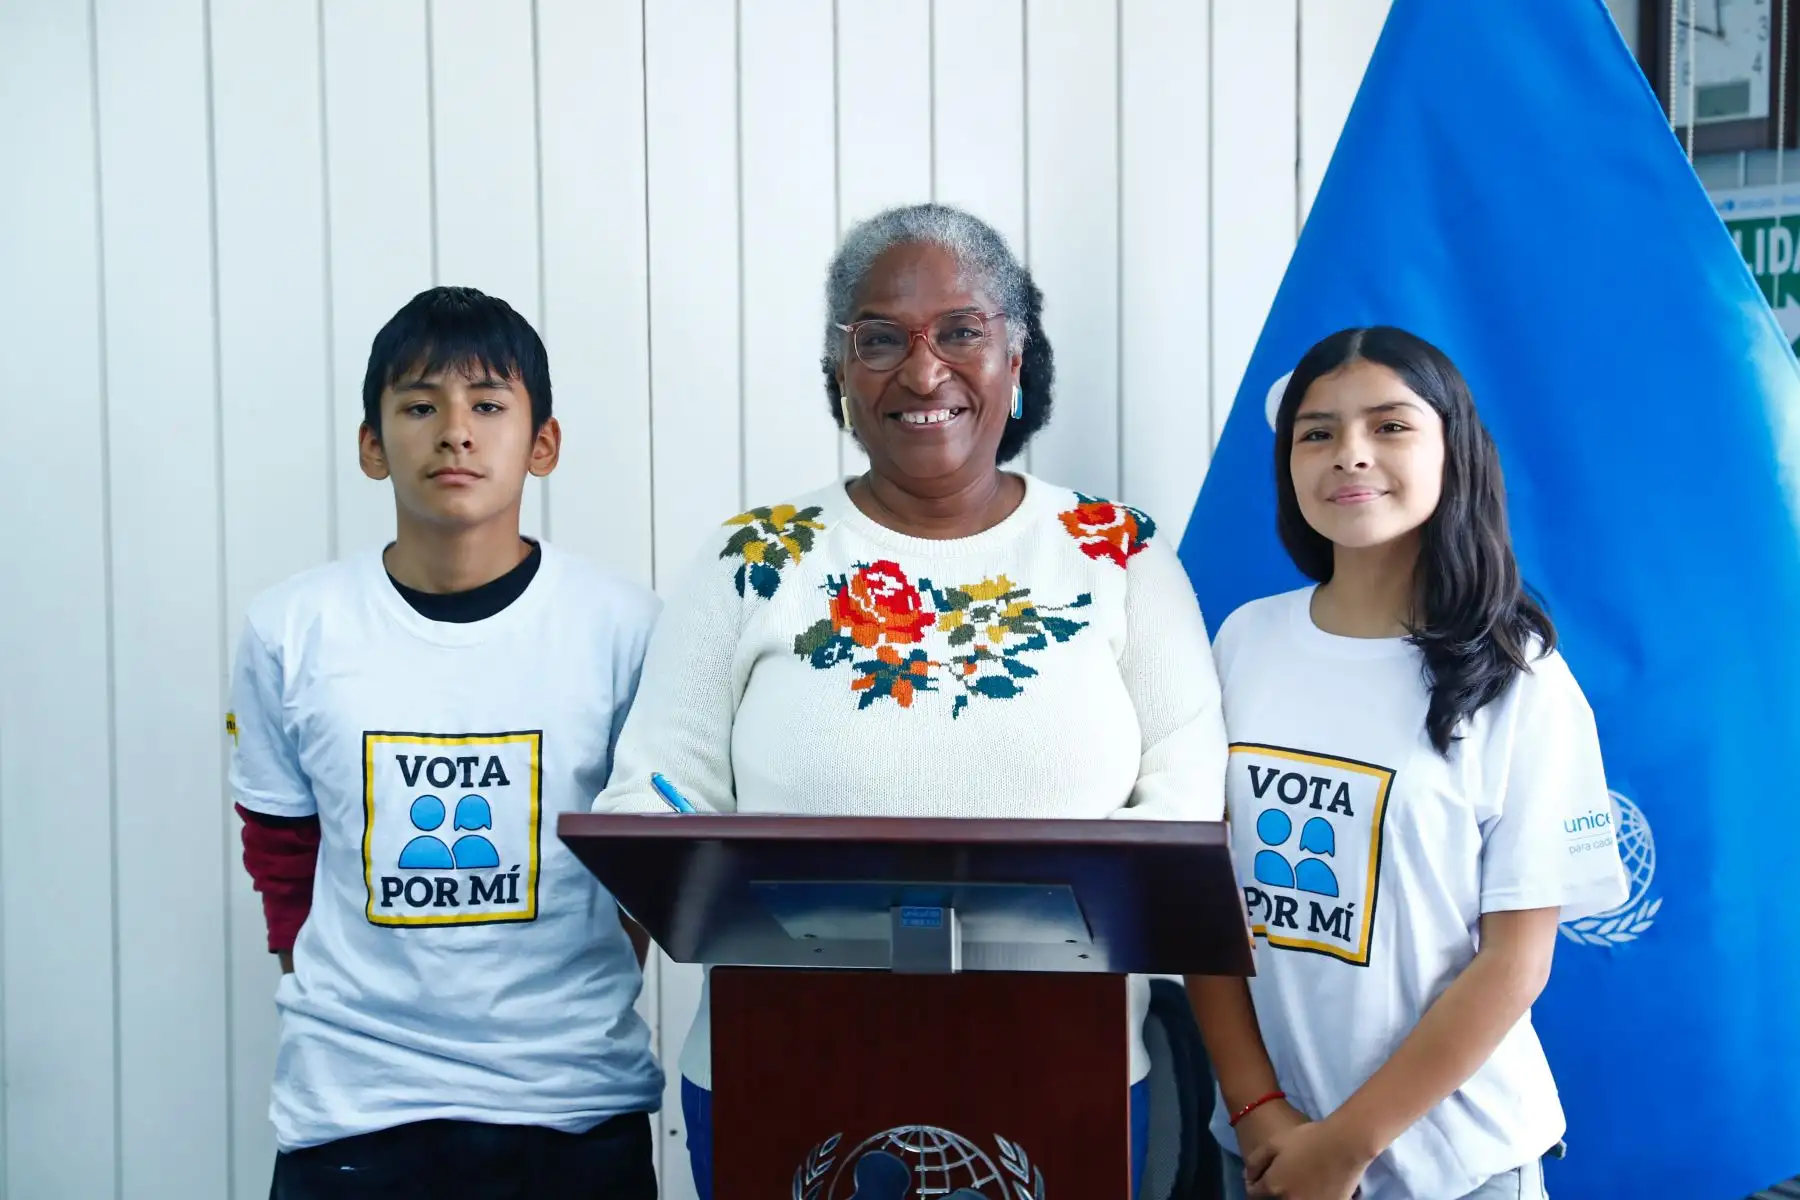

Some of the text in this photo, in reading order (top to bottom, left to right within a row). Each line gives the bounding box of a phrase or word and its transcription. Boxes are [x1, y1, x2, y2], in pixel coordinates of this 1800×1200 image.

[1732, 226, 1800, 275] LID
[396, 755, 510, 788] VOTA
[1248, 765, 1354, 817] VOTA
[1568, 843, 1592, 856] para
[381, 864, 520, 907] POR MÍ
[1307, 901, 1355, 942] MÍ
